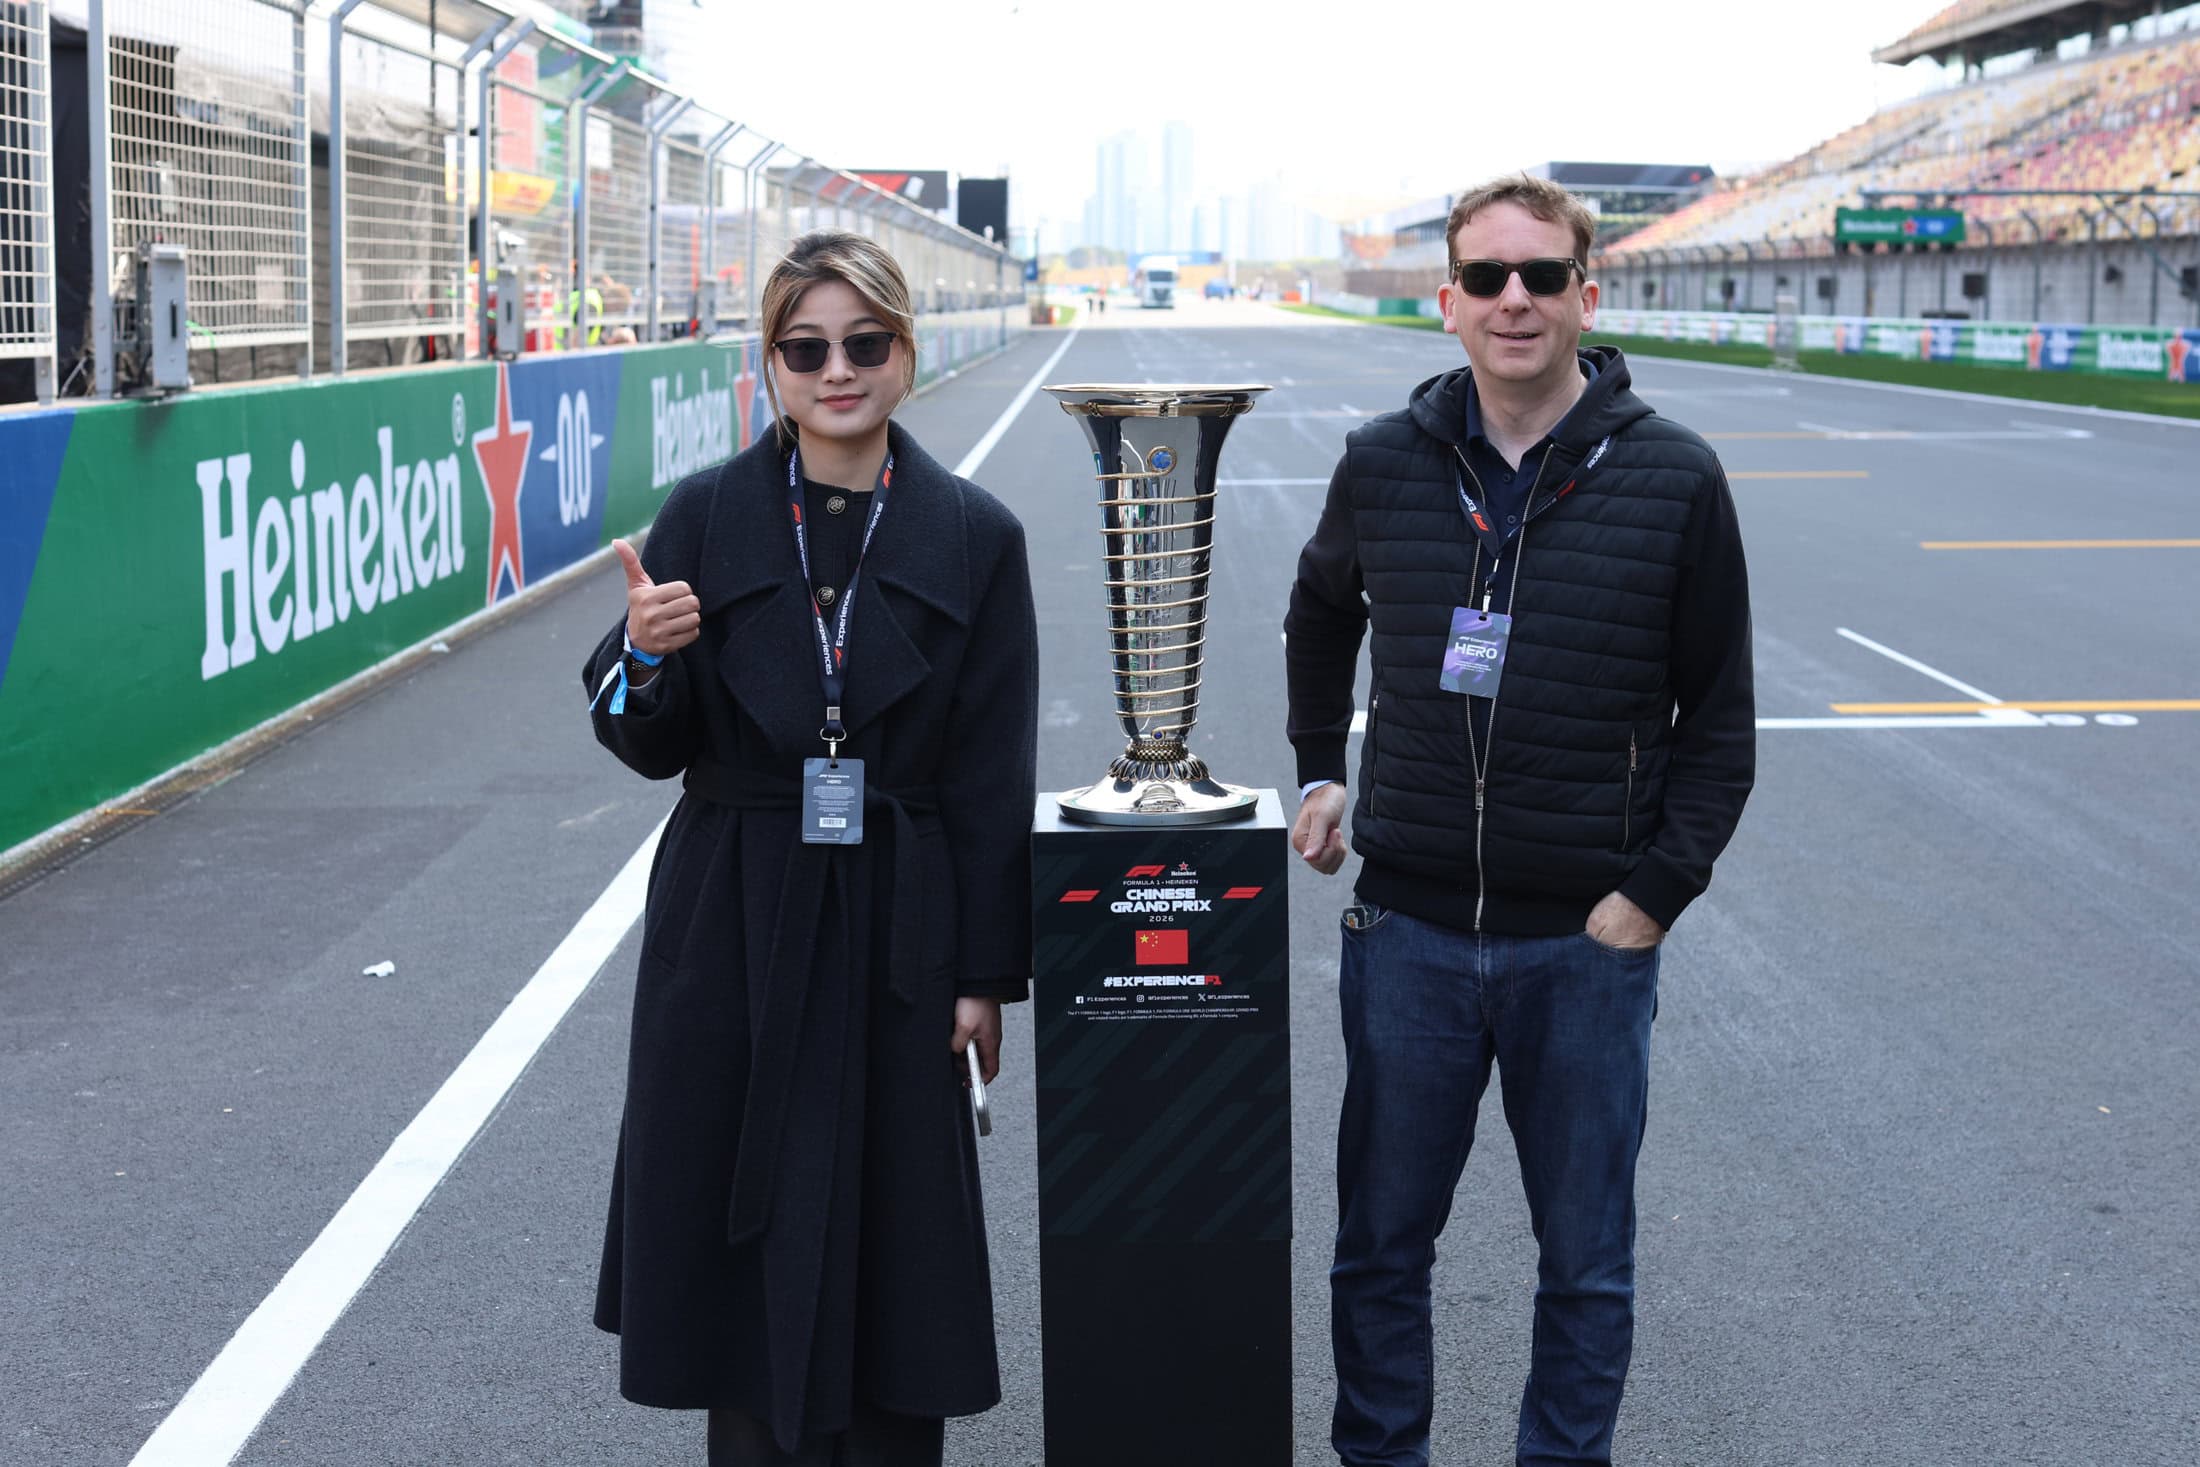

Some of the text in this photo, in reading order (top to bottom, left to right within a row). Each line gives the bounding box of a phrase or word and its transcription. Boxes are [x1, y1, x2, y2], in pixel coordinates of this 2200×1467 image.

[651, 368, 732, 490] Heineken
[196, 390, 592, 681] Heineken 0.0
[1454, 641, 1498, 660] HERO
[1126, 887, 1196, 900] CHINESE
[1110, 899, 1212, 913] GRAND PRIX
[1103, 974, 1222, 988] #EXPERIENCEF1
